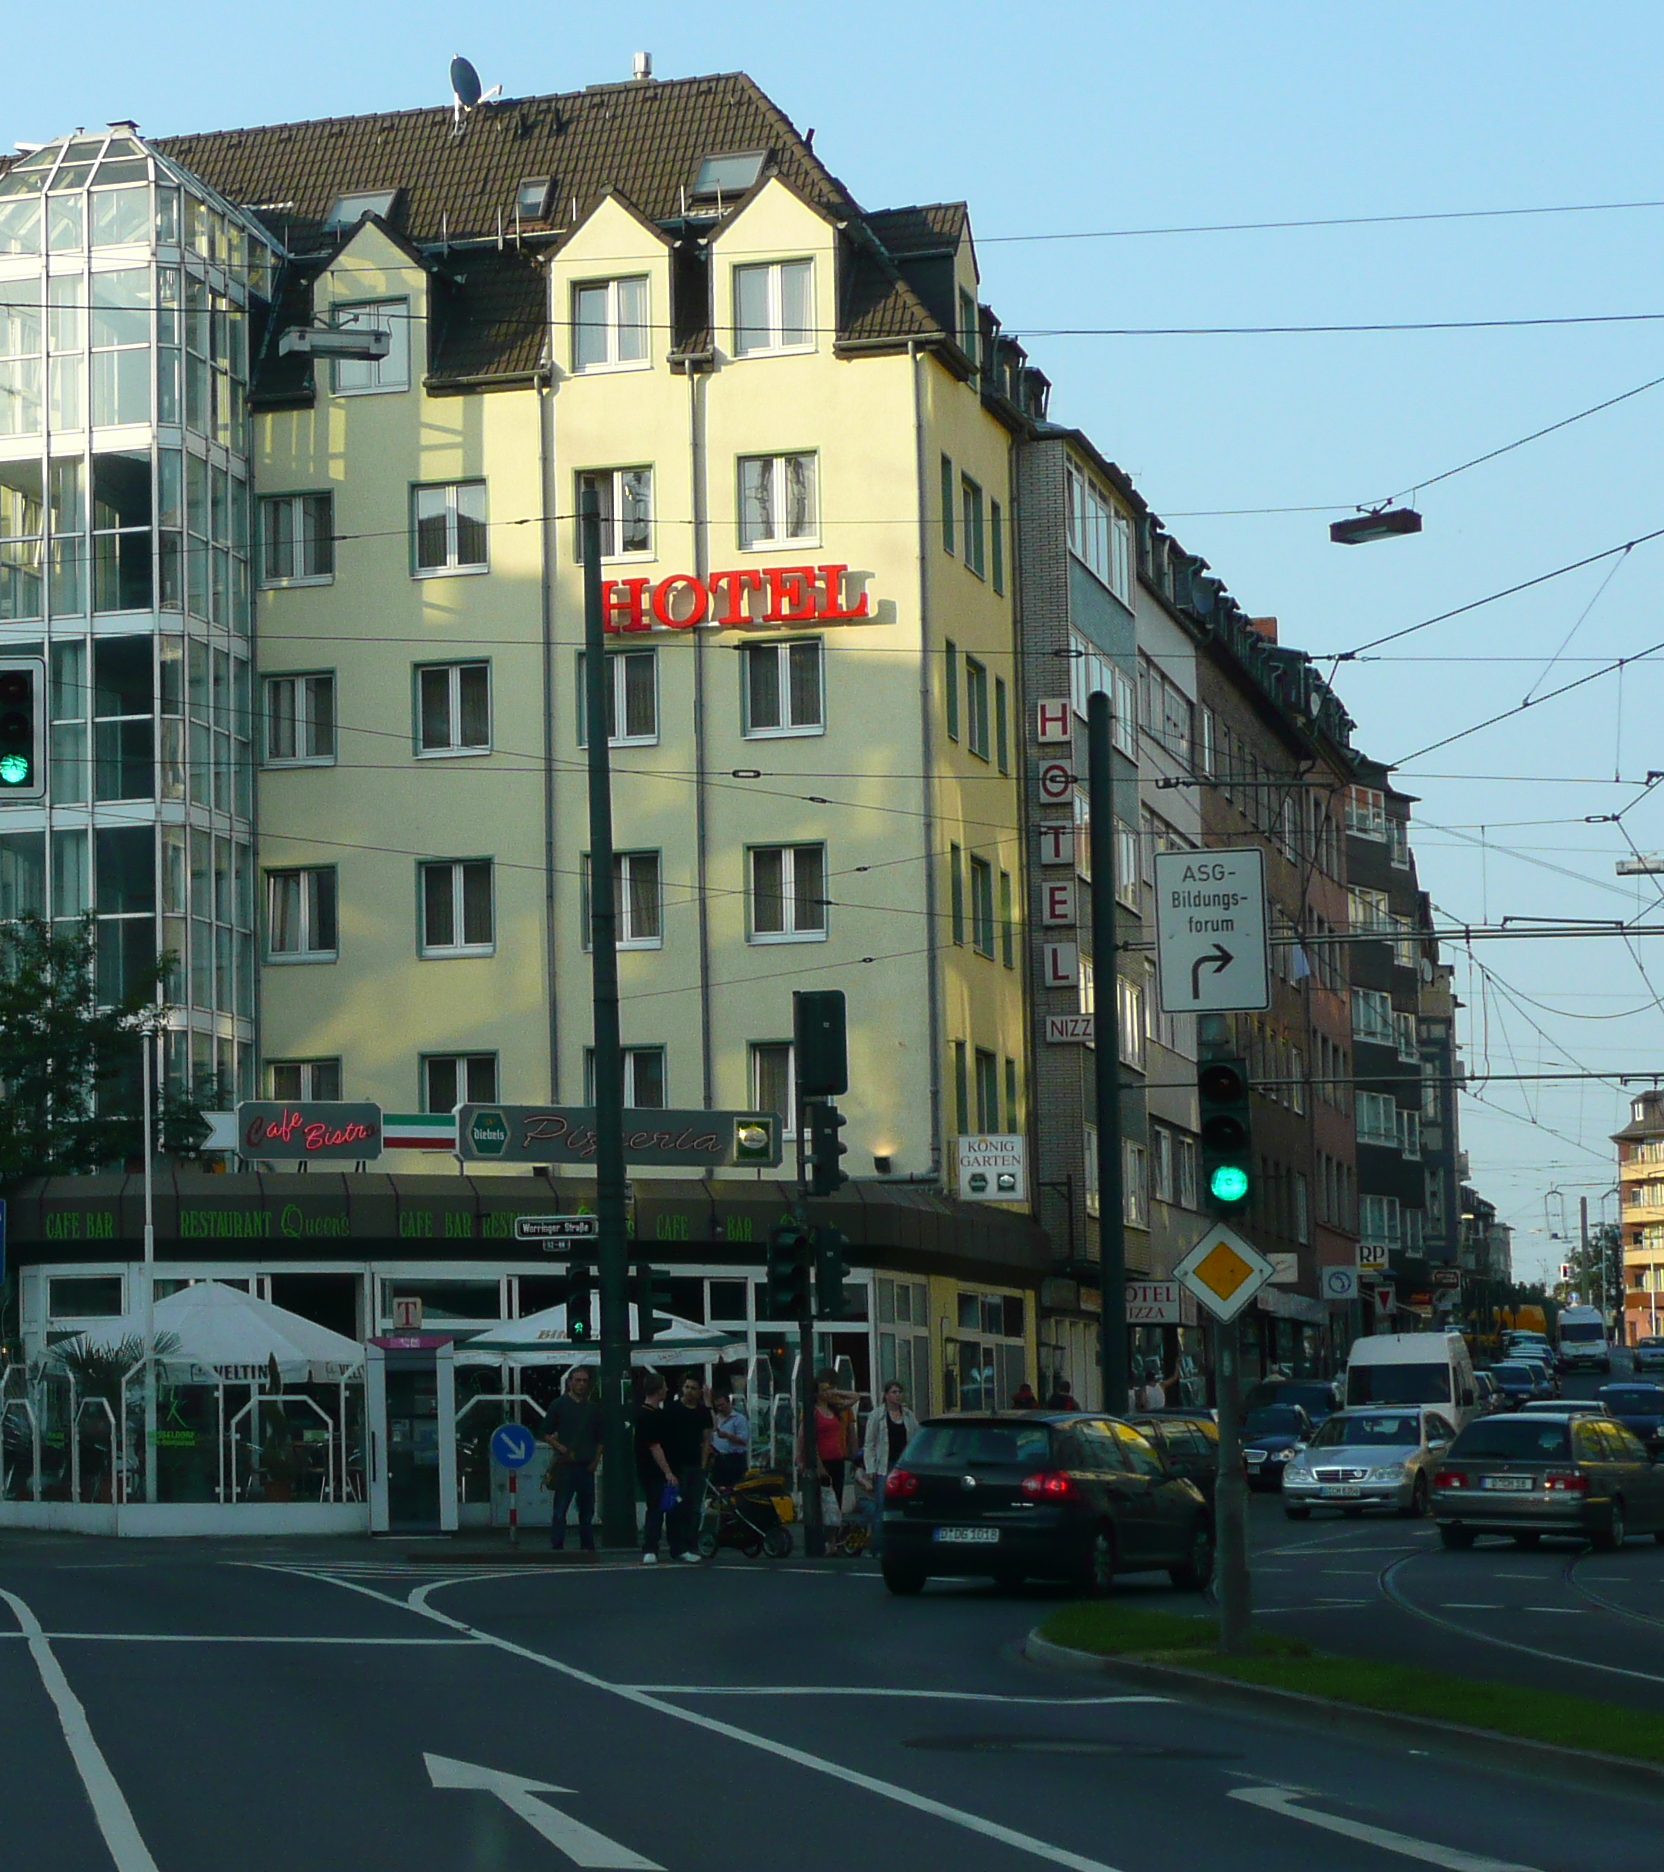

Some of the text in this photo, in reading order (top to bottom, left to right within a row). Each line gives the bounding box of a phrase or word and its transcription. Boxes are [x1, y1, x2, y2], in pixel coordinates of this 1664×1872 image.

[602, 565, 868, 633] HOTEL
[1040, 703, 1068, 980] HOTEL
[1182, 864, 1236, 882] ASG-
[1172, 890, 1248, 911] Bildungs-
[1188, 916, 1234, 933] forum
[1051, 1019, 1093, 1038] NIZZ
[303, 1122, 378, 1150] Bistro
[523, 1114, 723, 1158] Pizeria
[960, 1155, 1020, 1167] GARTEN
[86, 1212, 114, 1239] BAR
[180, 1211, 272, 1239] RESTAURANT
[399, 1211, 434, 1238] CAFE
[445, 1211, 472, 1238] BAR
[656, 1214, 689, 1241] CAFE
[726, 1215, 753, 1242] BAR
[1359, 1246, 1384, 1262] RP
[1126, 1286, 1176, 1302] OTEL
[397, 1302, 416, 1326] T
[1127, 1306, 1164, 1319] IZZA
[213, 1364, 271, 1380] VELTIN
